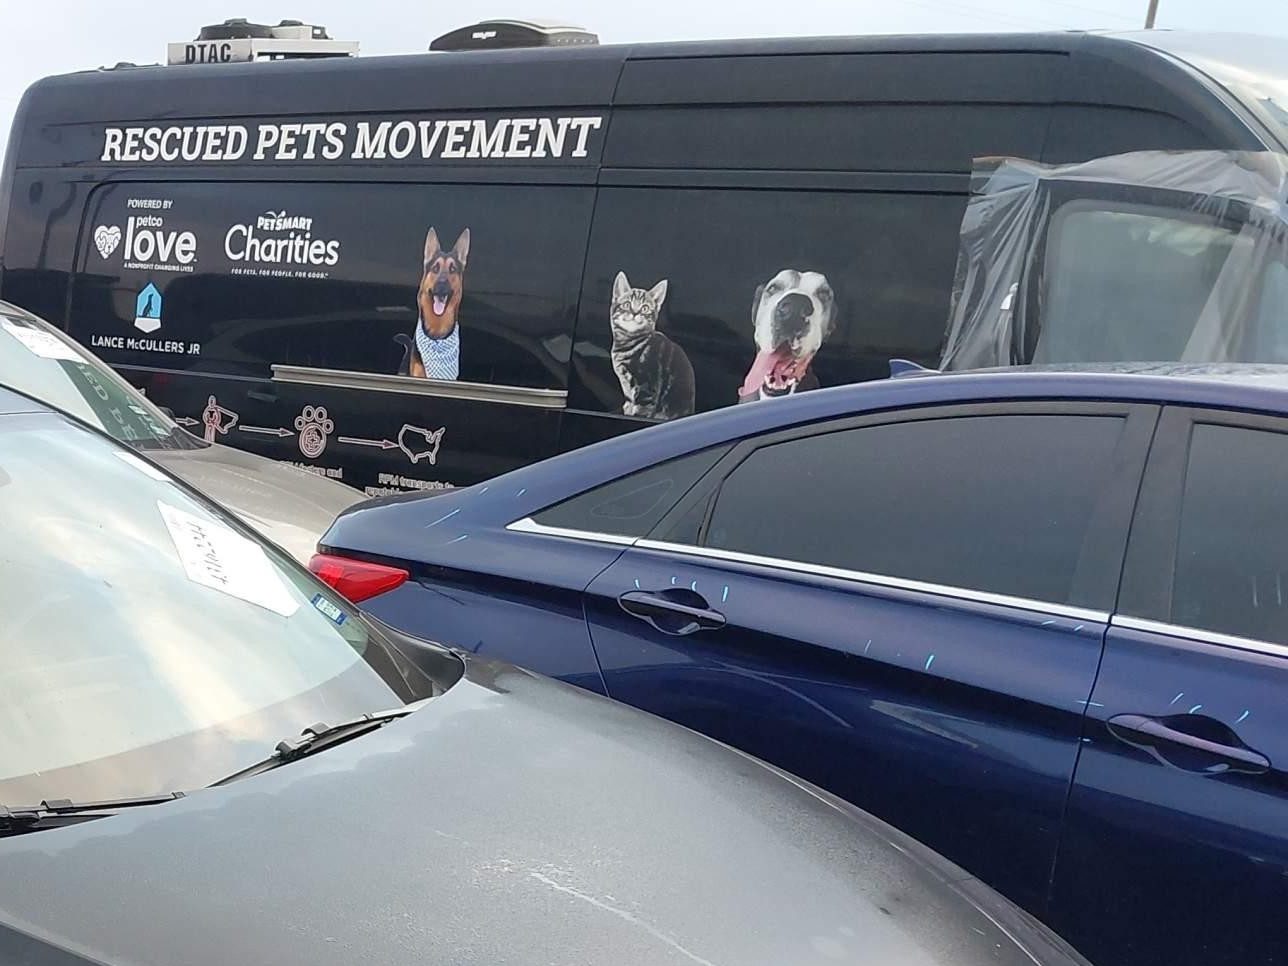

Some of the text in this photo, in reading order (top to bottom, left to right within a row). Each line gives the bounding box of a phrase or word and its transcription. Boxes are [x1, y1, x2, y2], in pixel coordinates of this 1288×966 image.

[101, 117, 602, 161] RESCUED PETS MOVEMENT
[127, 199, 173, 209] POWERED BY
[136, 215, 163, 228] petco
[225, 224, 340, 266] Charities
[91, 335, 200, 354] LANCE McCULLERS JR
